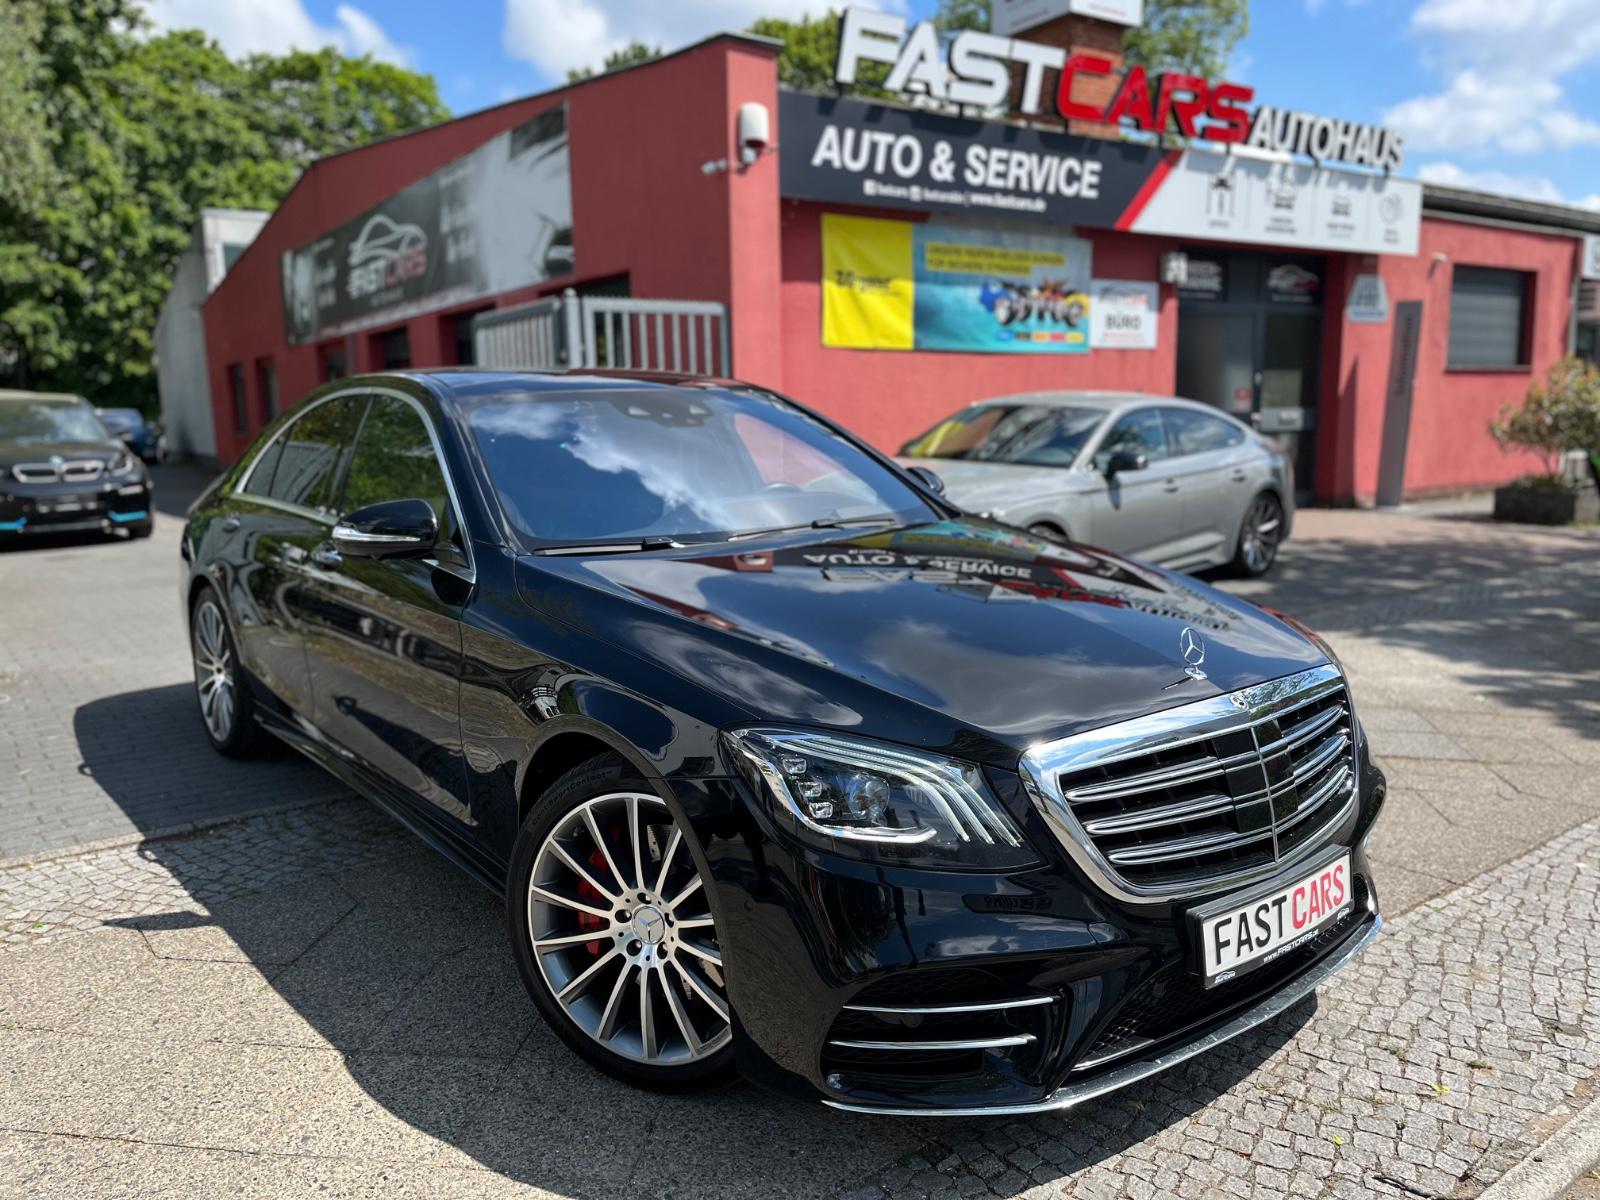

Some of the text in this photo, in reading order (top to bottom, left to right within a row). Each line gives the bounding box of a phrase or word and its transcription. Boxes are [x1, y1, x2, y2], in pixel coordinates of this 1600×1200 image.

[812, 125, 1103, 199] AUTO & SERVICE
[1248, 105, 1404, 170] AUTOHAUS
[1104, 311, 1142, 331] BÜRO
